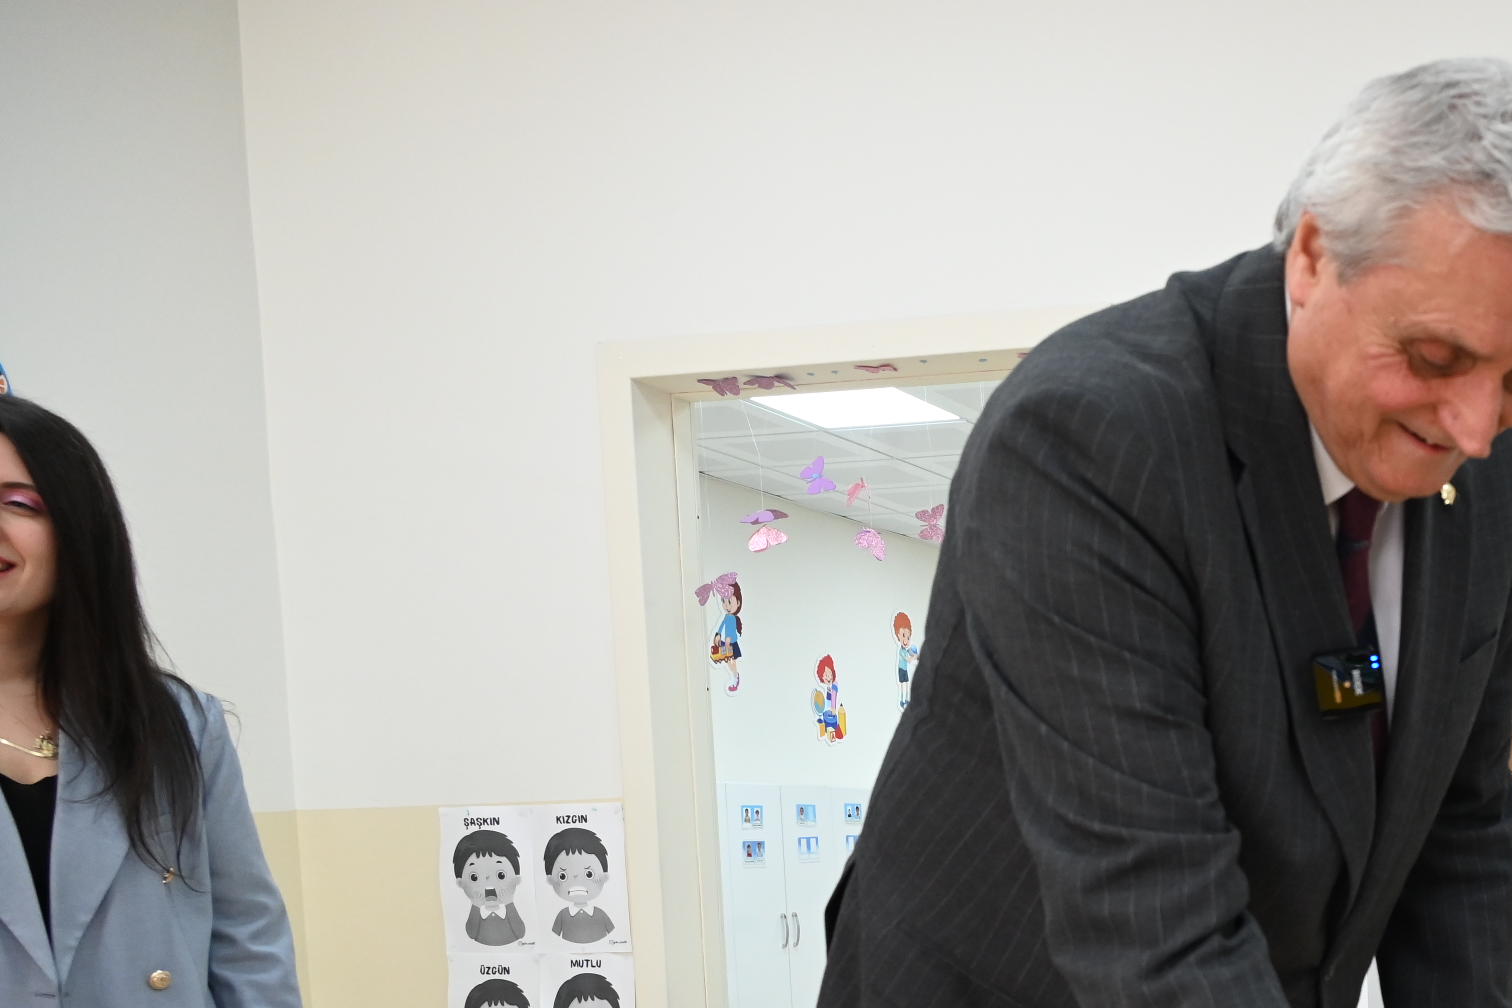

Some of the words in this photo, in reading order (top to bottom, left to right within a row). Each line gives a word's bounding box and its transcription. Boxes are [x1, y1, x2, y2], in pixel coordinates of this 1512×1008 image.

[463, 817, 501, 830] ŞAŞKIN
[555, 814, 588, 824] KIZGIN
[570, 959, 602, 969] MUTLU
[479, 964, 511, 975] ÜZGÜN
